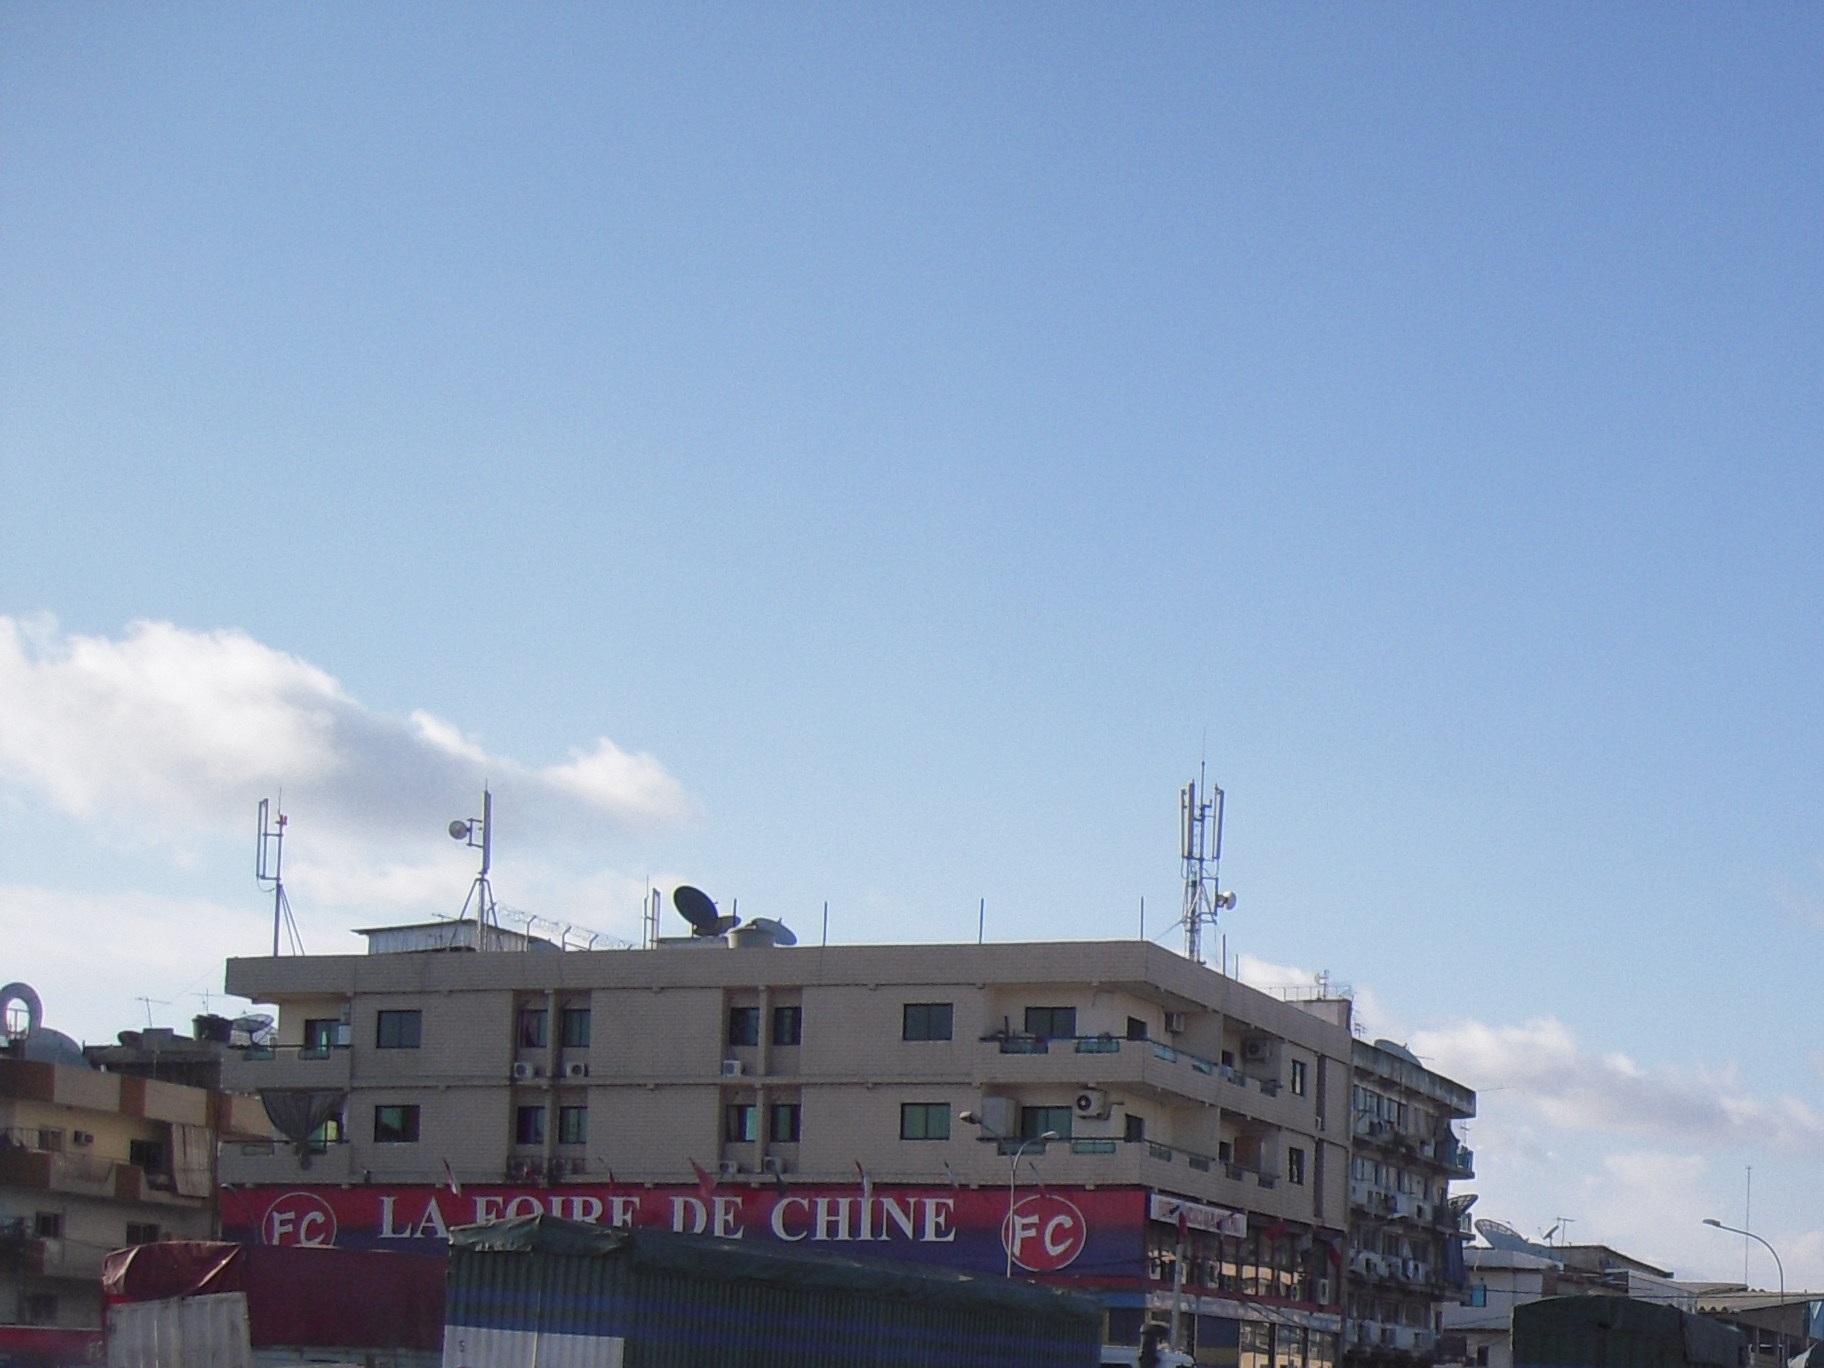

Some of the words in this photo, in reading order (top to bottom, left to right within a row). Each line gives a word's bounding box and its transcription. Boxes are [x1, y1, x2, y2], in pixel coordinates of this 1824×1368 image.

[272, 1210, 326, 1246] FC
[377, 1196, 450, 1239] LA
[669, 1196, 745, 1240] DE
[771, 1197, 957, 1243] CHINE
[1013, 1214, 1076, 1257] FC
